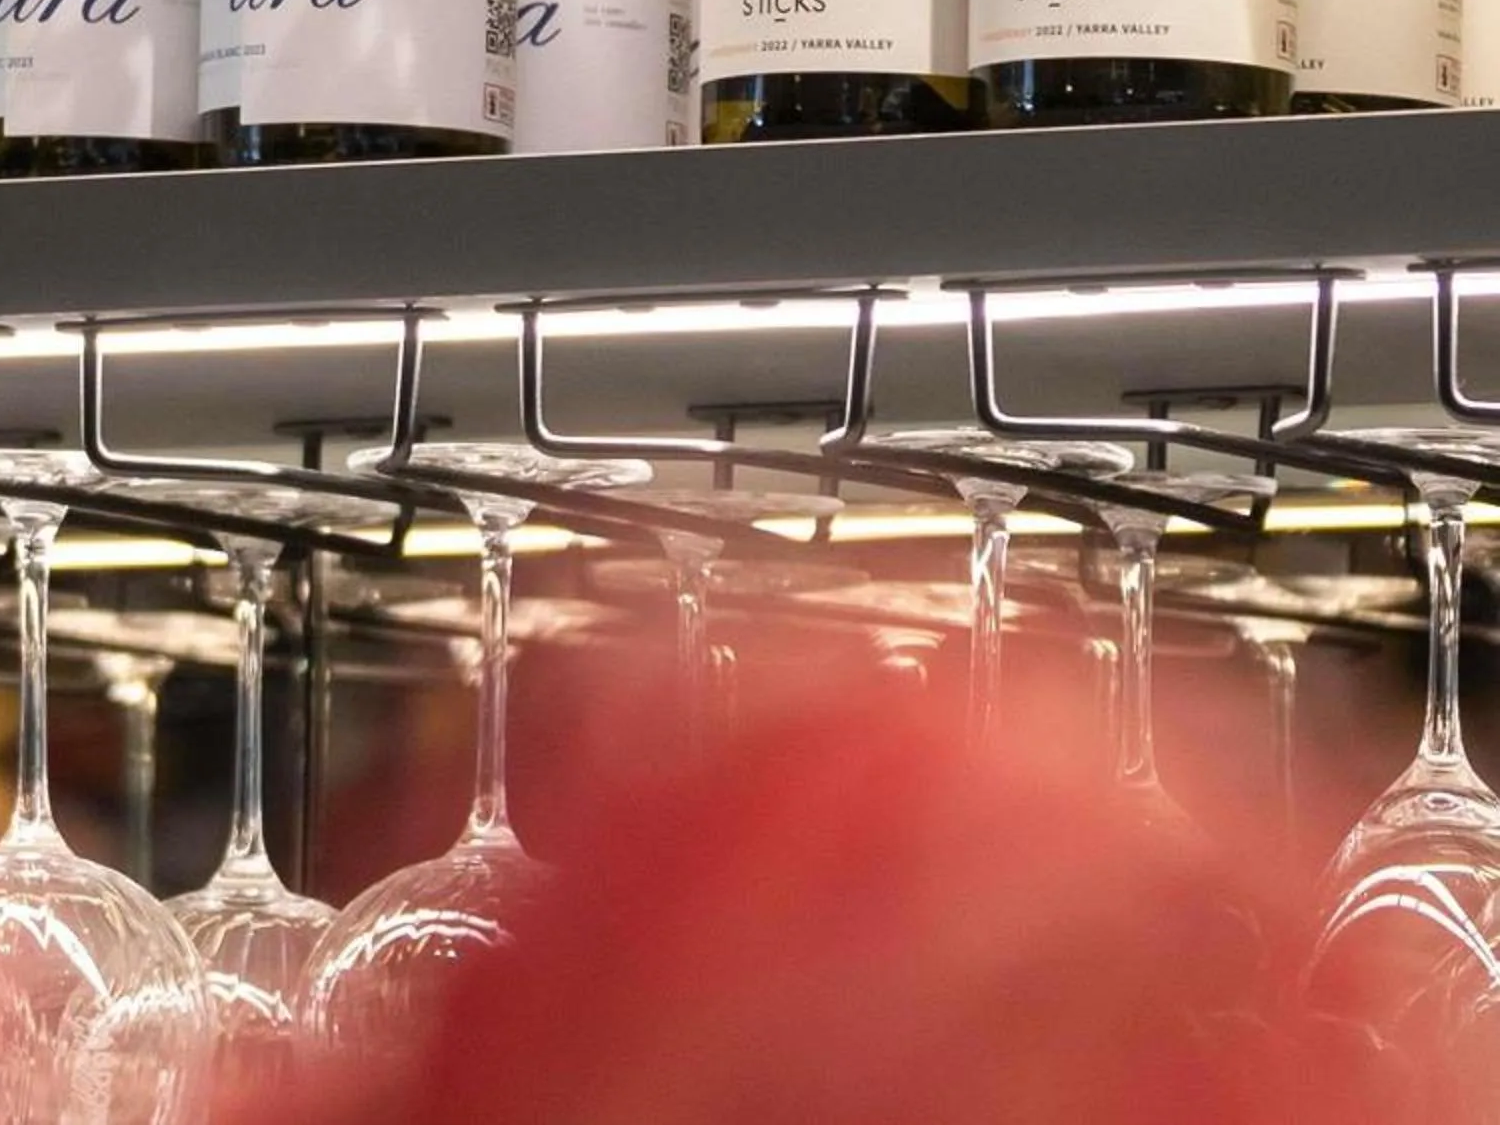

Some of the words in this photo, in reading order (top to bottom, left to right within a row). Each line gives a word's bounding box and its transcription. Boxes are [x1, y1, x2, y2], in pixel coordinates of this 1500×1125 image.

[1035, 25, 1063, 37] 2022
[1076, 24, 1118, 35] YARRA
[1121, 24, 1171, 36] VALLEY
[761, 40, 788, 52] 2022
[800, 39, 842, 50] YARRA
[844, 39, 895, 51] VALLEY
[1298, 59, 1326, 71] LEY
